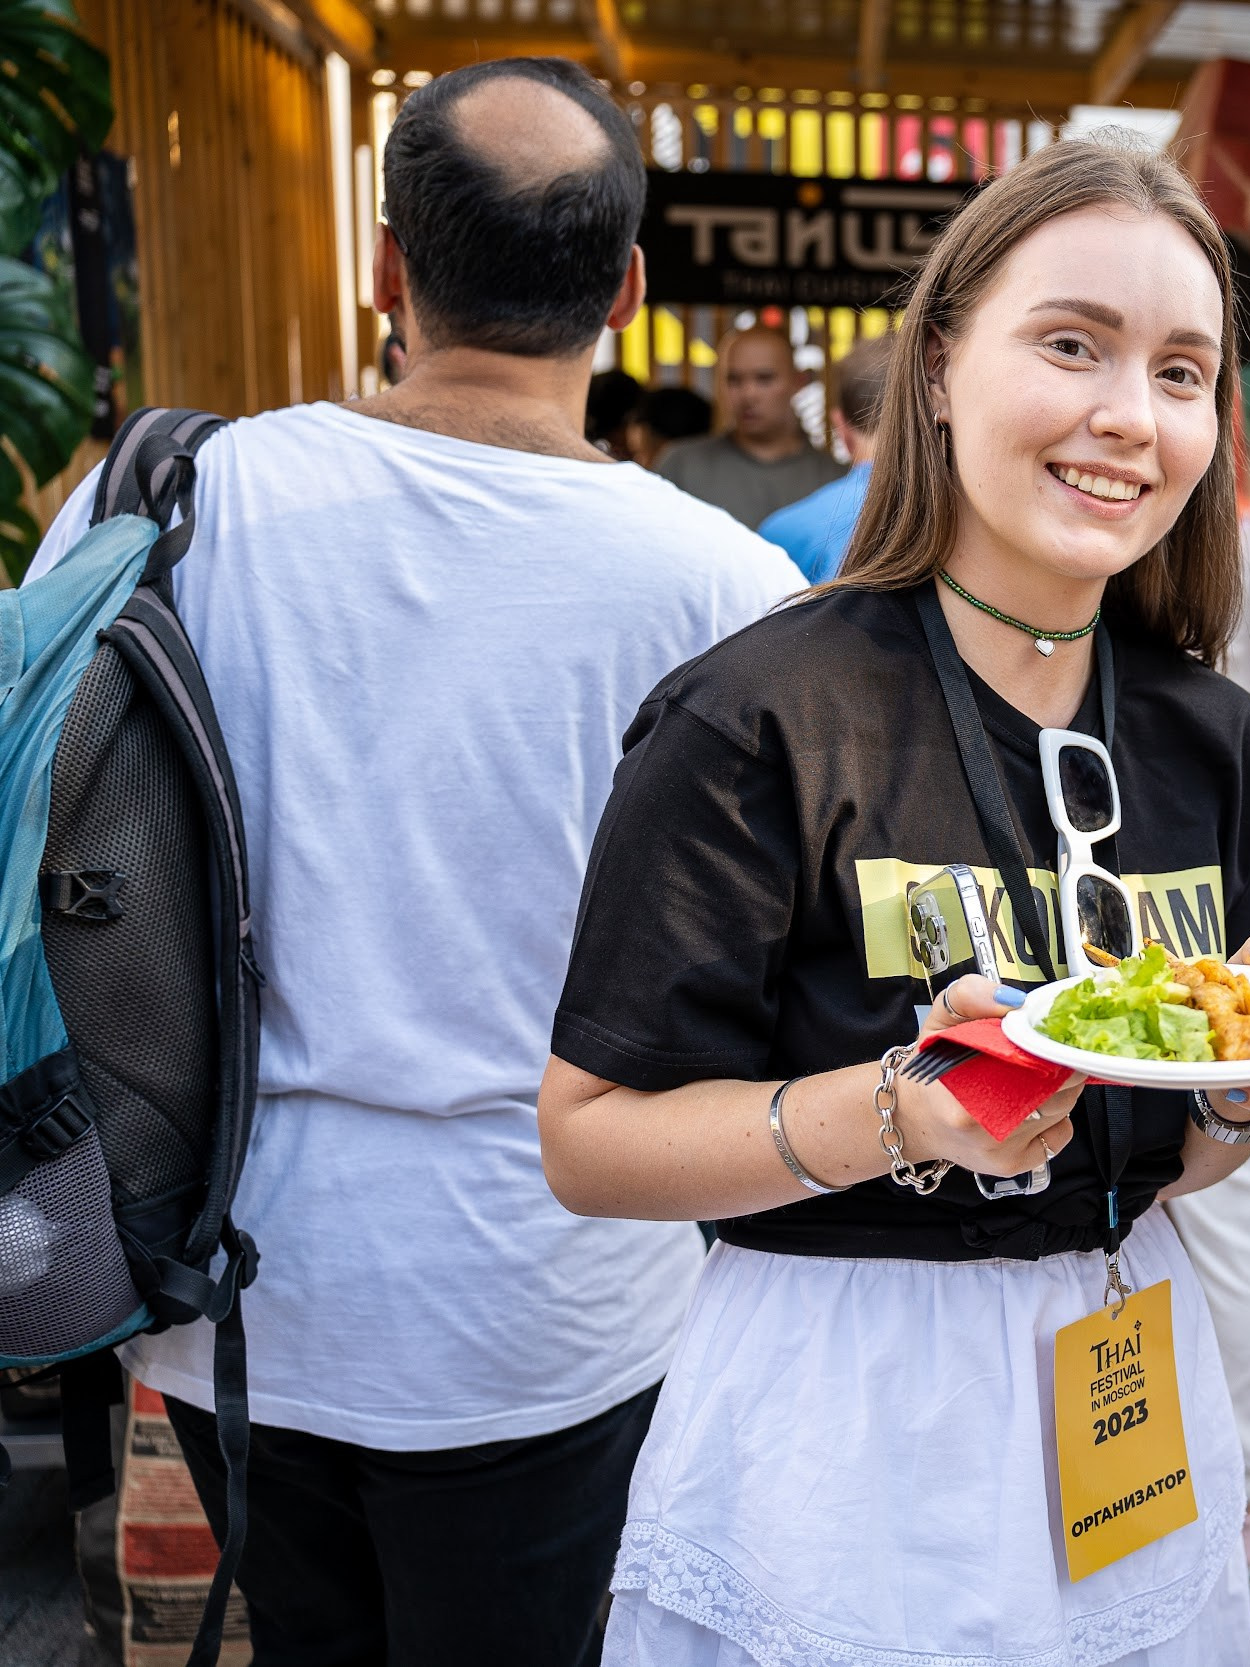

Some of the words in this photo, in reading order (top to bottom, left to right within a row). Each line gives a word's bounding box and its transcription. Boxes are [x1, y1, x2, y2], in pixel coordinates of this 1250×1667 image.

[1090, 1360, 1145, 1397] FESTIVAL
[1091, 1399, 1101, 1412] IN
[1103, 1377, 1146, 1408] MOSCOW
[1092, 1397, 1149, 1446] 2023
[1070, 1468, 1188, 1538] ОРГАНИЗАТОР
